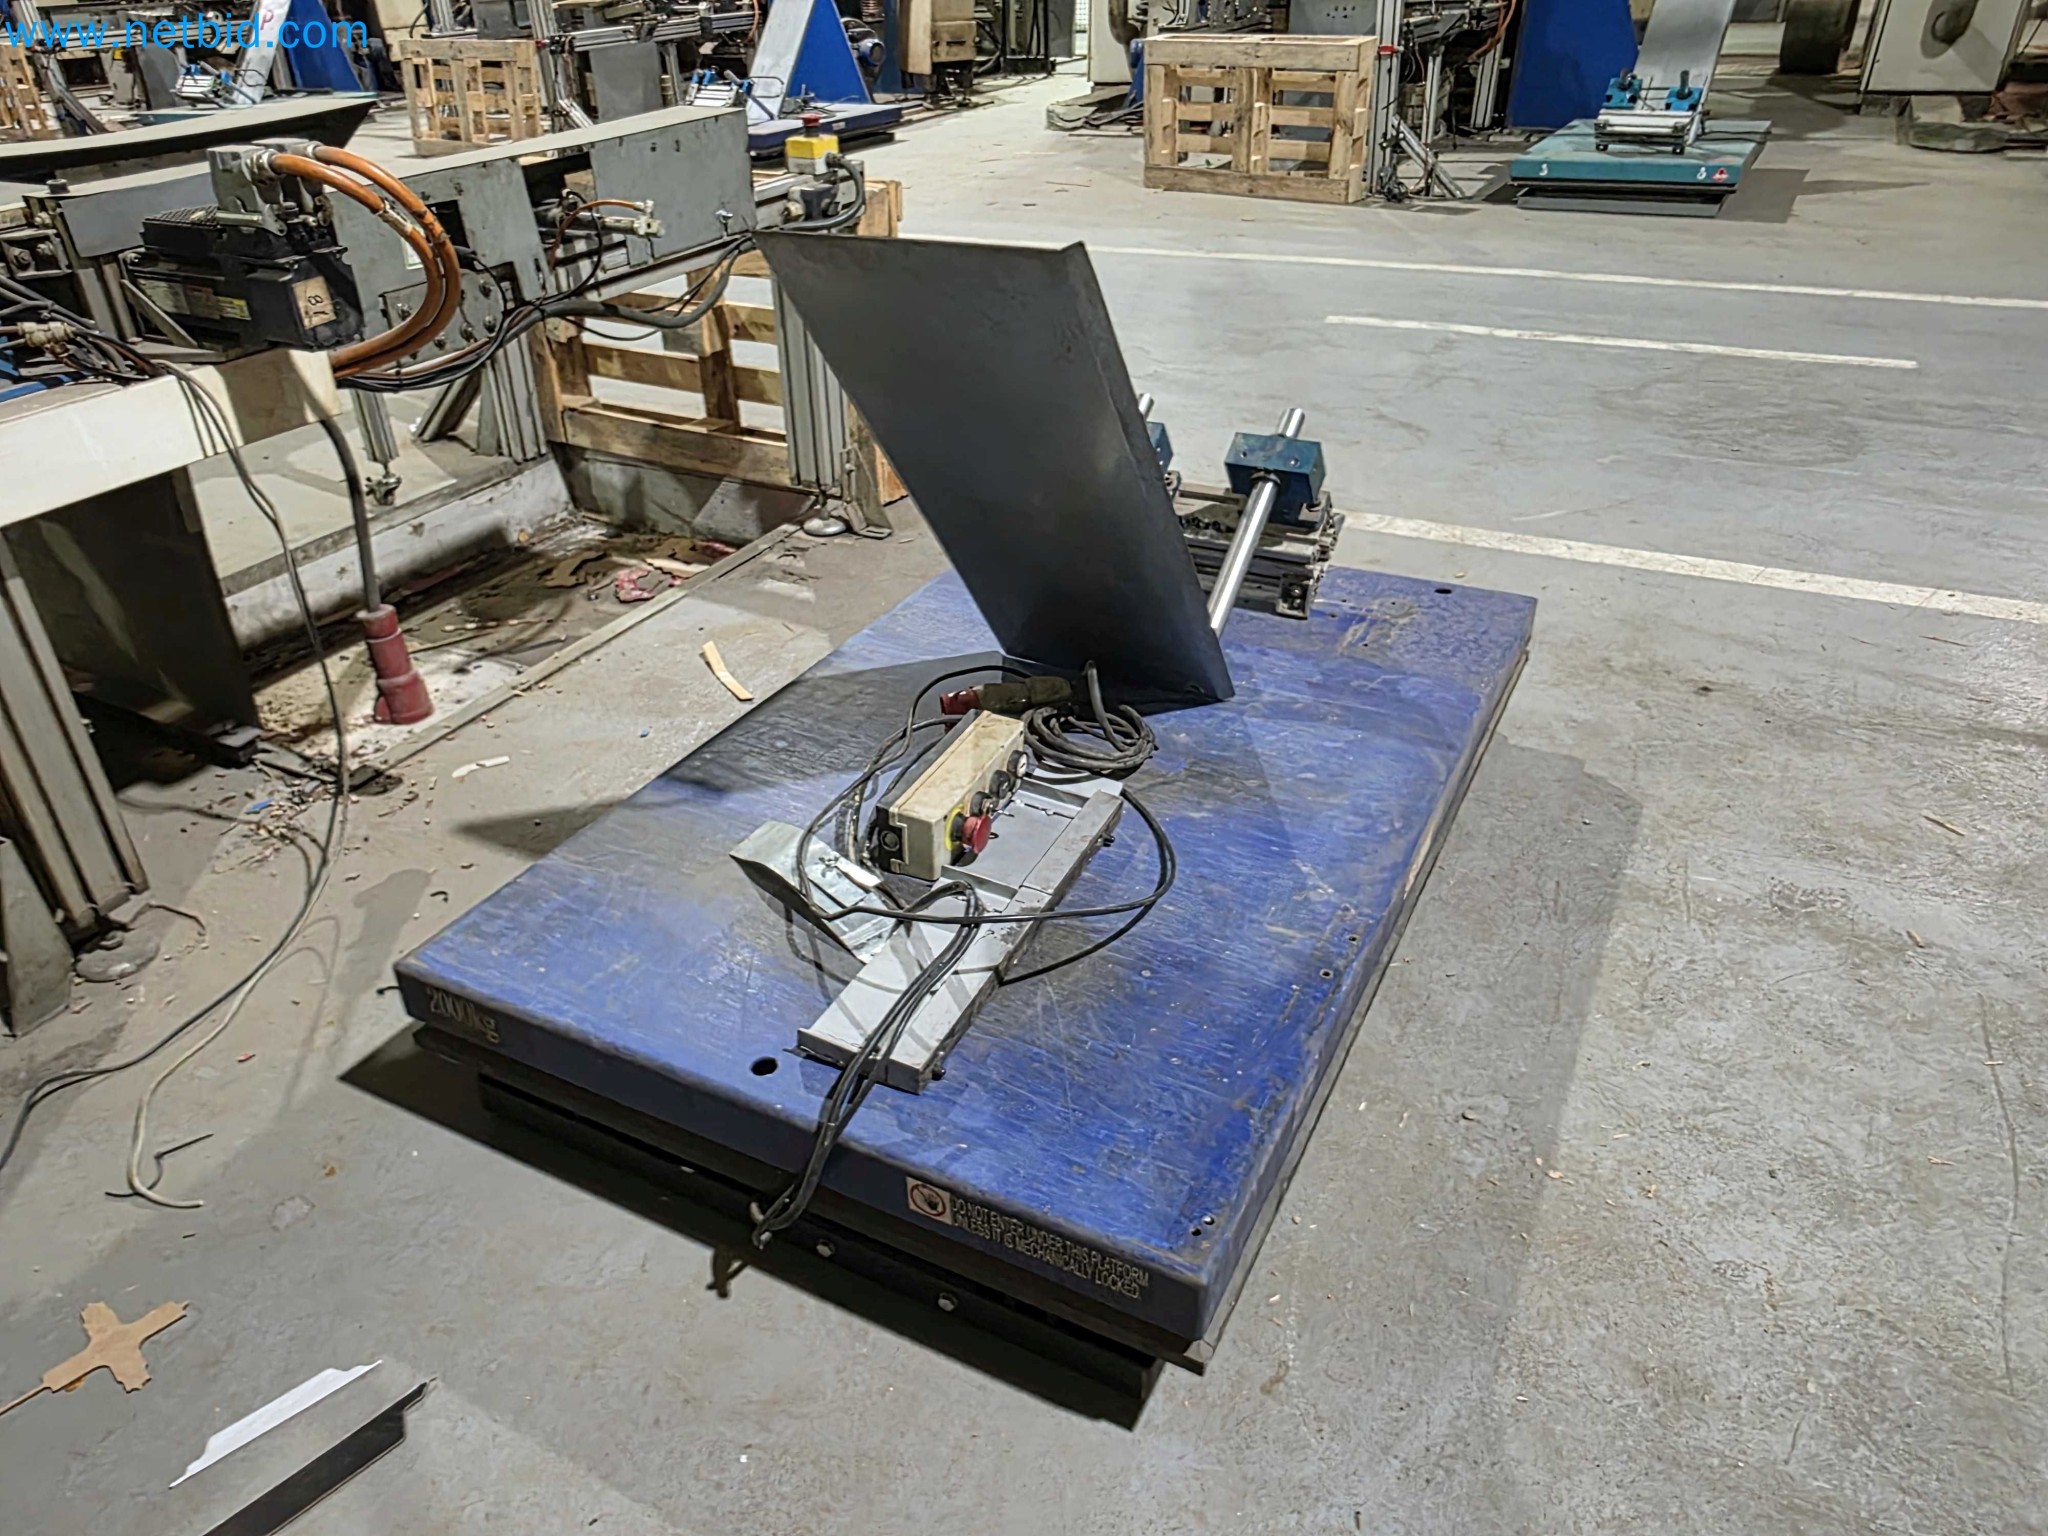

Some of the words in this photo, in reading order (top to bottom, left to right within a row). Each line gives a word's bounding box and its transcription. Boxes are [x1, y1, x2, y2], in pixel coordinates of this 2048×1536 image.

[953, 1211, 991, 1241] UNLESS
[1016, 1237, 1093, 1279] MECHANICALLY
[968, 1202, 989, 1223] NOT
[990, 1211, 1025, 1238] ENTER
[1025, 1224, 1063, 1252] UNDER
[1064, 1239, 1088, 1264] THIS
[1090, 1250, 1149, 1288] PLATFORM
